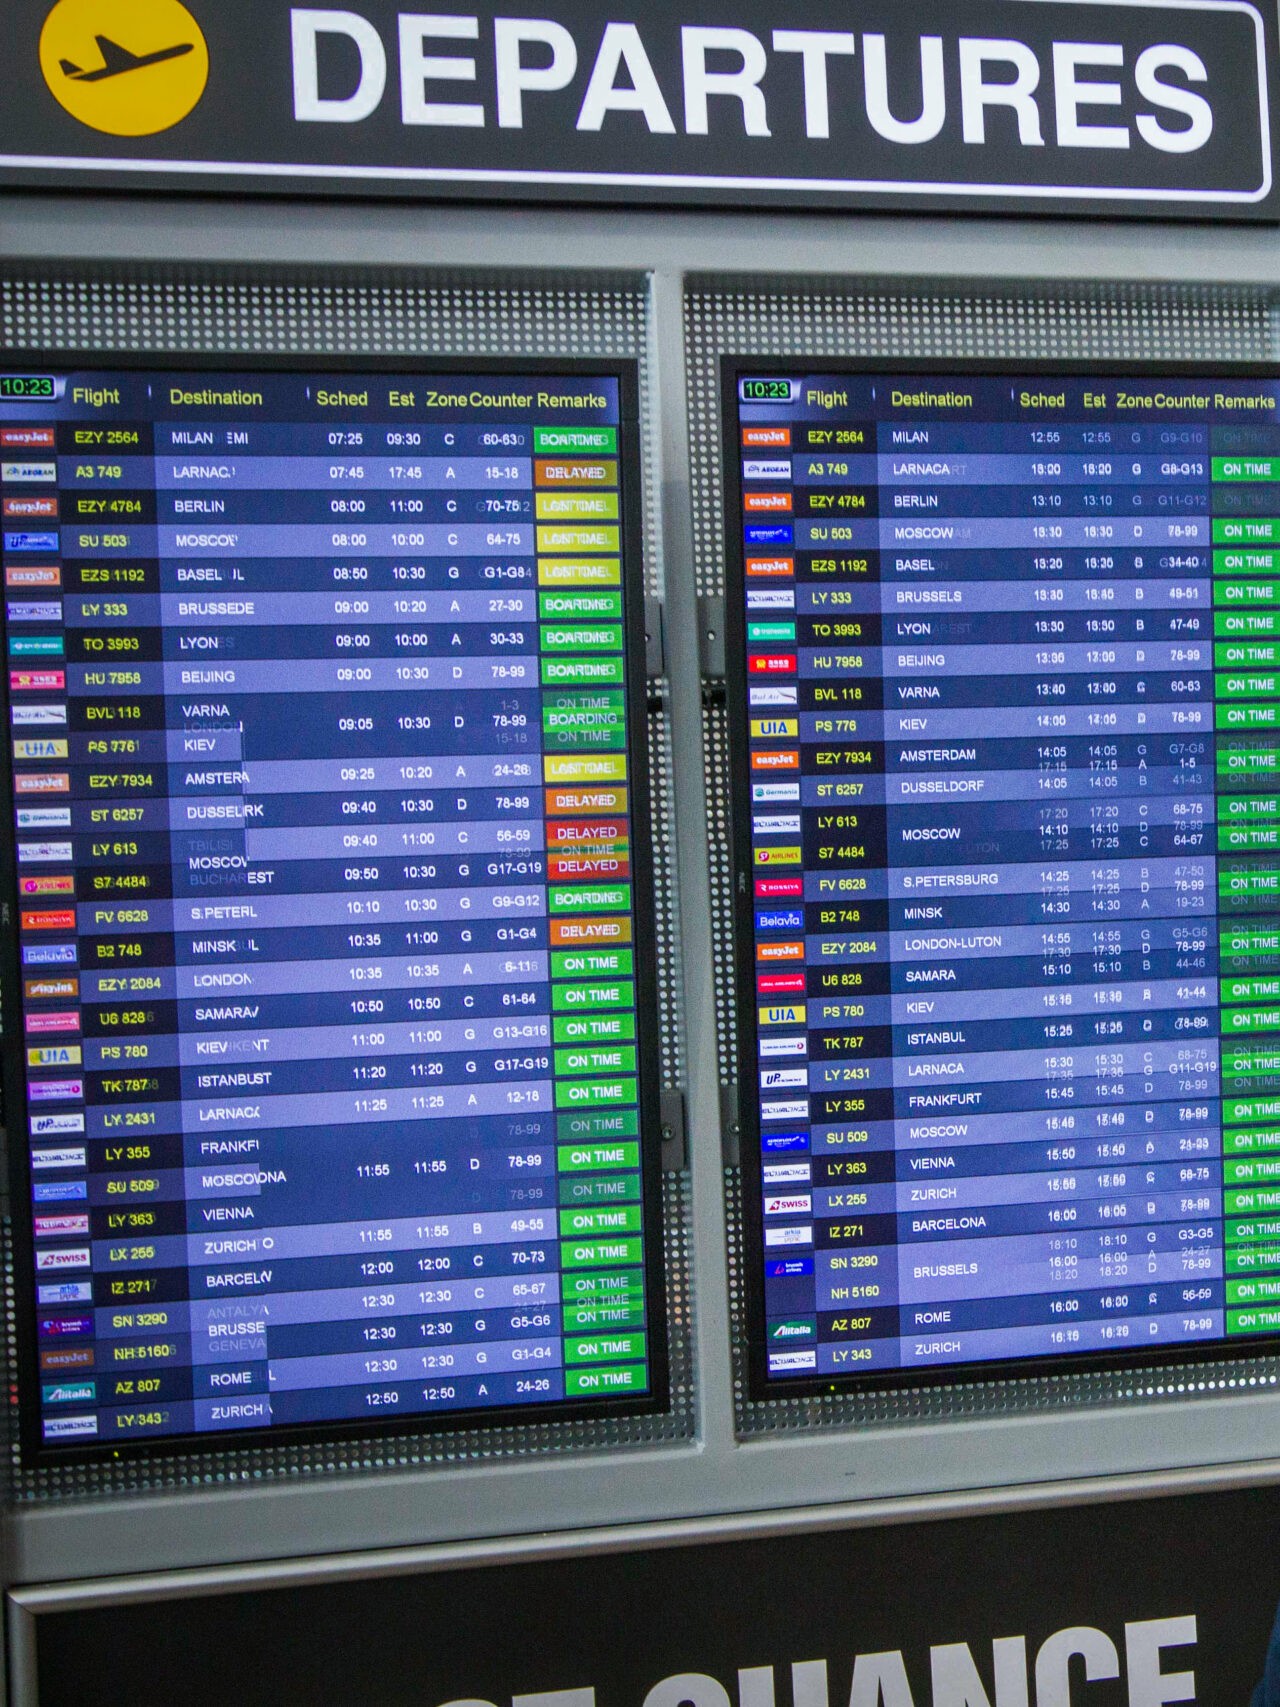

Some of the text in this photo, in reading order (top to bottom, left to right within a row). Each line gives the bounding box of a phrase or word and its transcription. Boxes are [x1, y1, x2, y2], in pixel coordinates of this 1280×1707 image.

[292, 8, 1214, 152] DEPARTURES
[2, 379, 607, 408] 10:23 Flight Destination Sched Est Zone Counter Remarks
[745, 382, 1276, 409] 10:23 Flight Destination Sched Est Zone Counter Remarks
[75, 431, 139, 443] EZY 2564
[747, 431, 929, 443] easyJet EZY 2564 MILAN
[893, 463, 1271, 475] LARNACA ON TIME
[174, 500, 423, 513] BERLIN 08:00 11:00
[810, 495, 938, 507] EZY 4784 BERLIN
[897, 623, 931, 635] LYON
[181, 671, 235, 683] BEIJING
[898, 686, 940, 699] VARNA
[182, 705, 230, 717] VARNA
[761, 718, 927, 734] UIA PS 776 KIEV
[900, 747, 1067, 762] AMSTERDAM 14:05
[817, 780, 985, 796] ST 6257 DUSSELDORF
[344, 859, 618, 880] 09:50 10:30 G17-G19 DELAYED
[819, 873, 999, 891] FV 6628 S.PETERSBURG
[760, 906, 943, 926] Belavia B2 748 MINSK
[821, 935, 1002, 955] EZY 2084 LONDON-LUTON
[906, 964, 1072, 982] SAMARA 15:10
[824, 1031, 966, 1050] TK 787 ISTANBUL
[353, 1053, 621, 1079] 11:20 11:20 G17-G19 ON TIME
[826, 1087, 1074, 1113] LY 355 FRANKFURT 15:45
[357, 1149, 625, 1177] 11:55 11:55 D 78-99 ON TIME
[910, 1157, 955, 1170] VIENNA
[781, 1188, 957, 1209] SWISS ZURICH
[202, 1207, 254, 1221] VIENNA
[912, 1217, 986, 1232] BARCELONA
[56, 1253, 87, 1264] SWISS
[913, 1263, 978, 1278] BRUSSELS
[773, 1311, 951, 1337] Alitalia ROME
[915, 1341, 961, 1356] ZURICH
[1238, 1315, 1256, 1326] ON
[115, 1372, 252, 1394] AZ 807 ROME
[365, 1372, 632, 1405] 12:50 12:50 A 24-26 ON TIME
